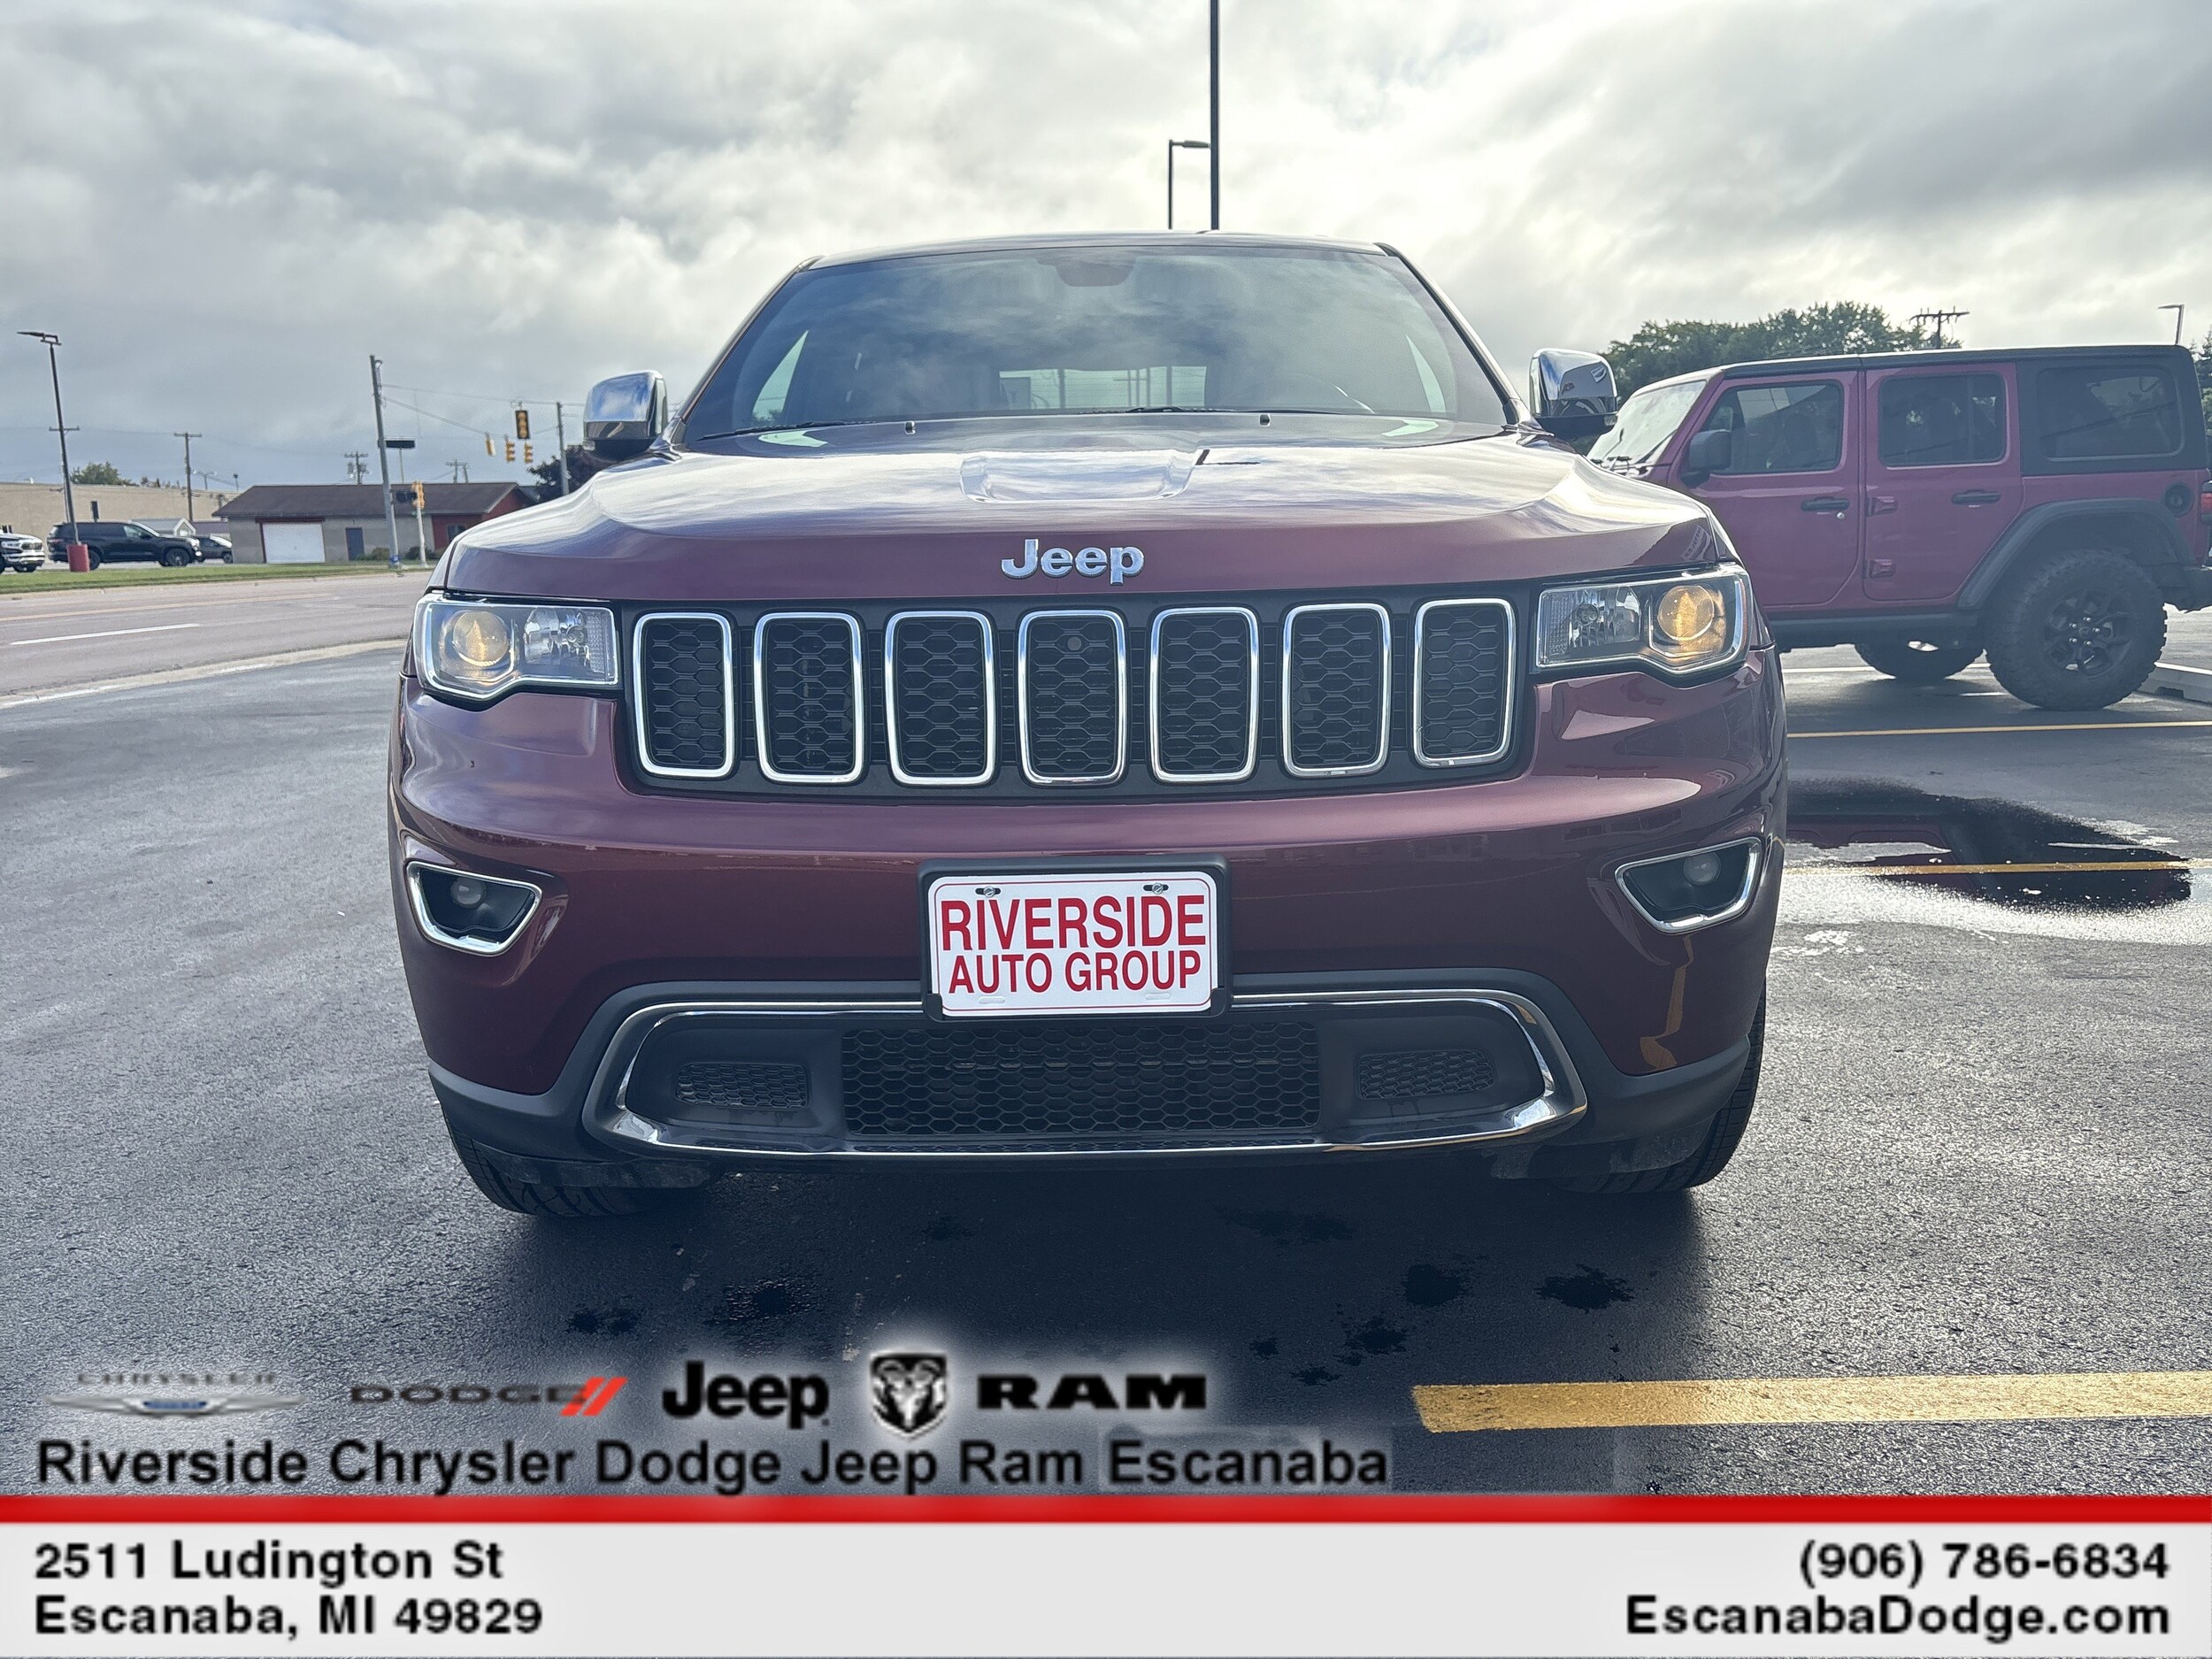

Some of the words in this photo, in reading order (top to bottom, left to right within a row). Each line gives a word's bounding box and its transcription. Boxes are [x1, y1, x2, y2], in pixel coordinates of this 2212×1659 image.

[1001, 538, 1145, 587] Jeep
[940, 894, 1207, 951] RIVERSIDE
[948, 952, 1053, 995] AUTO
[1064, 949, 1202, 992] GROUP
